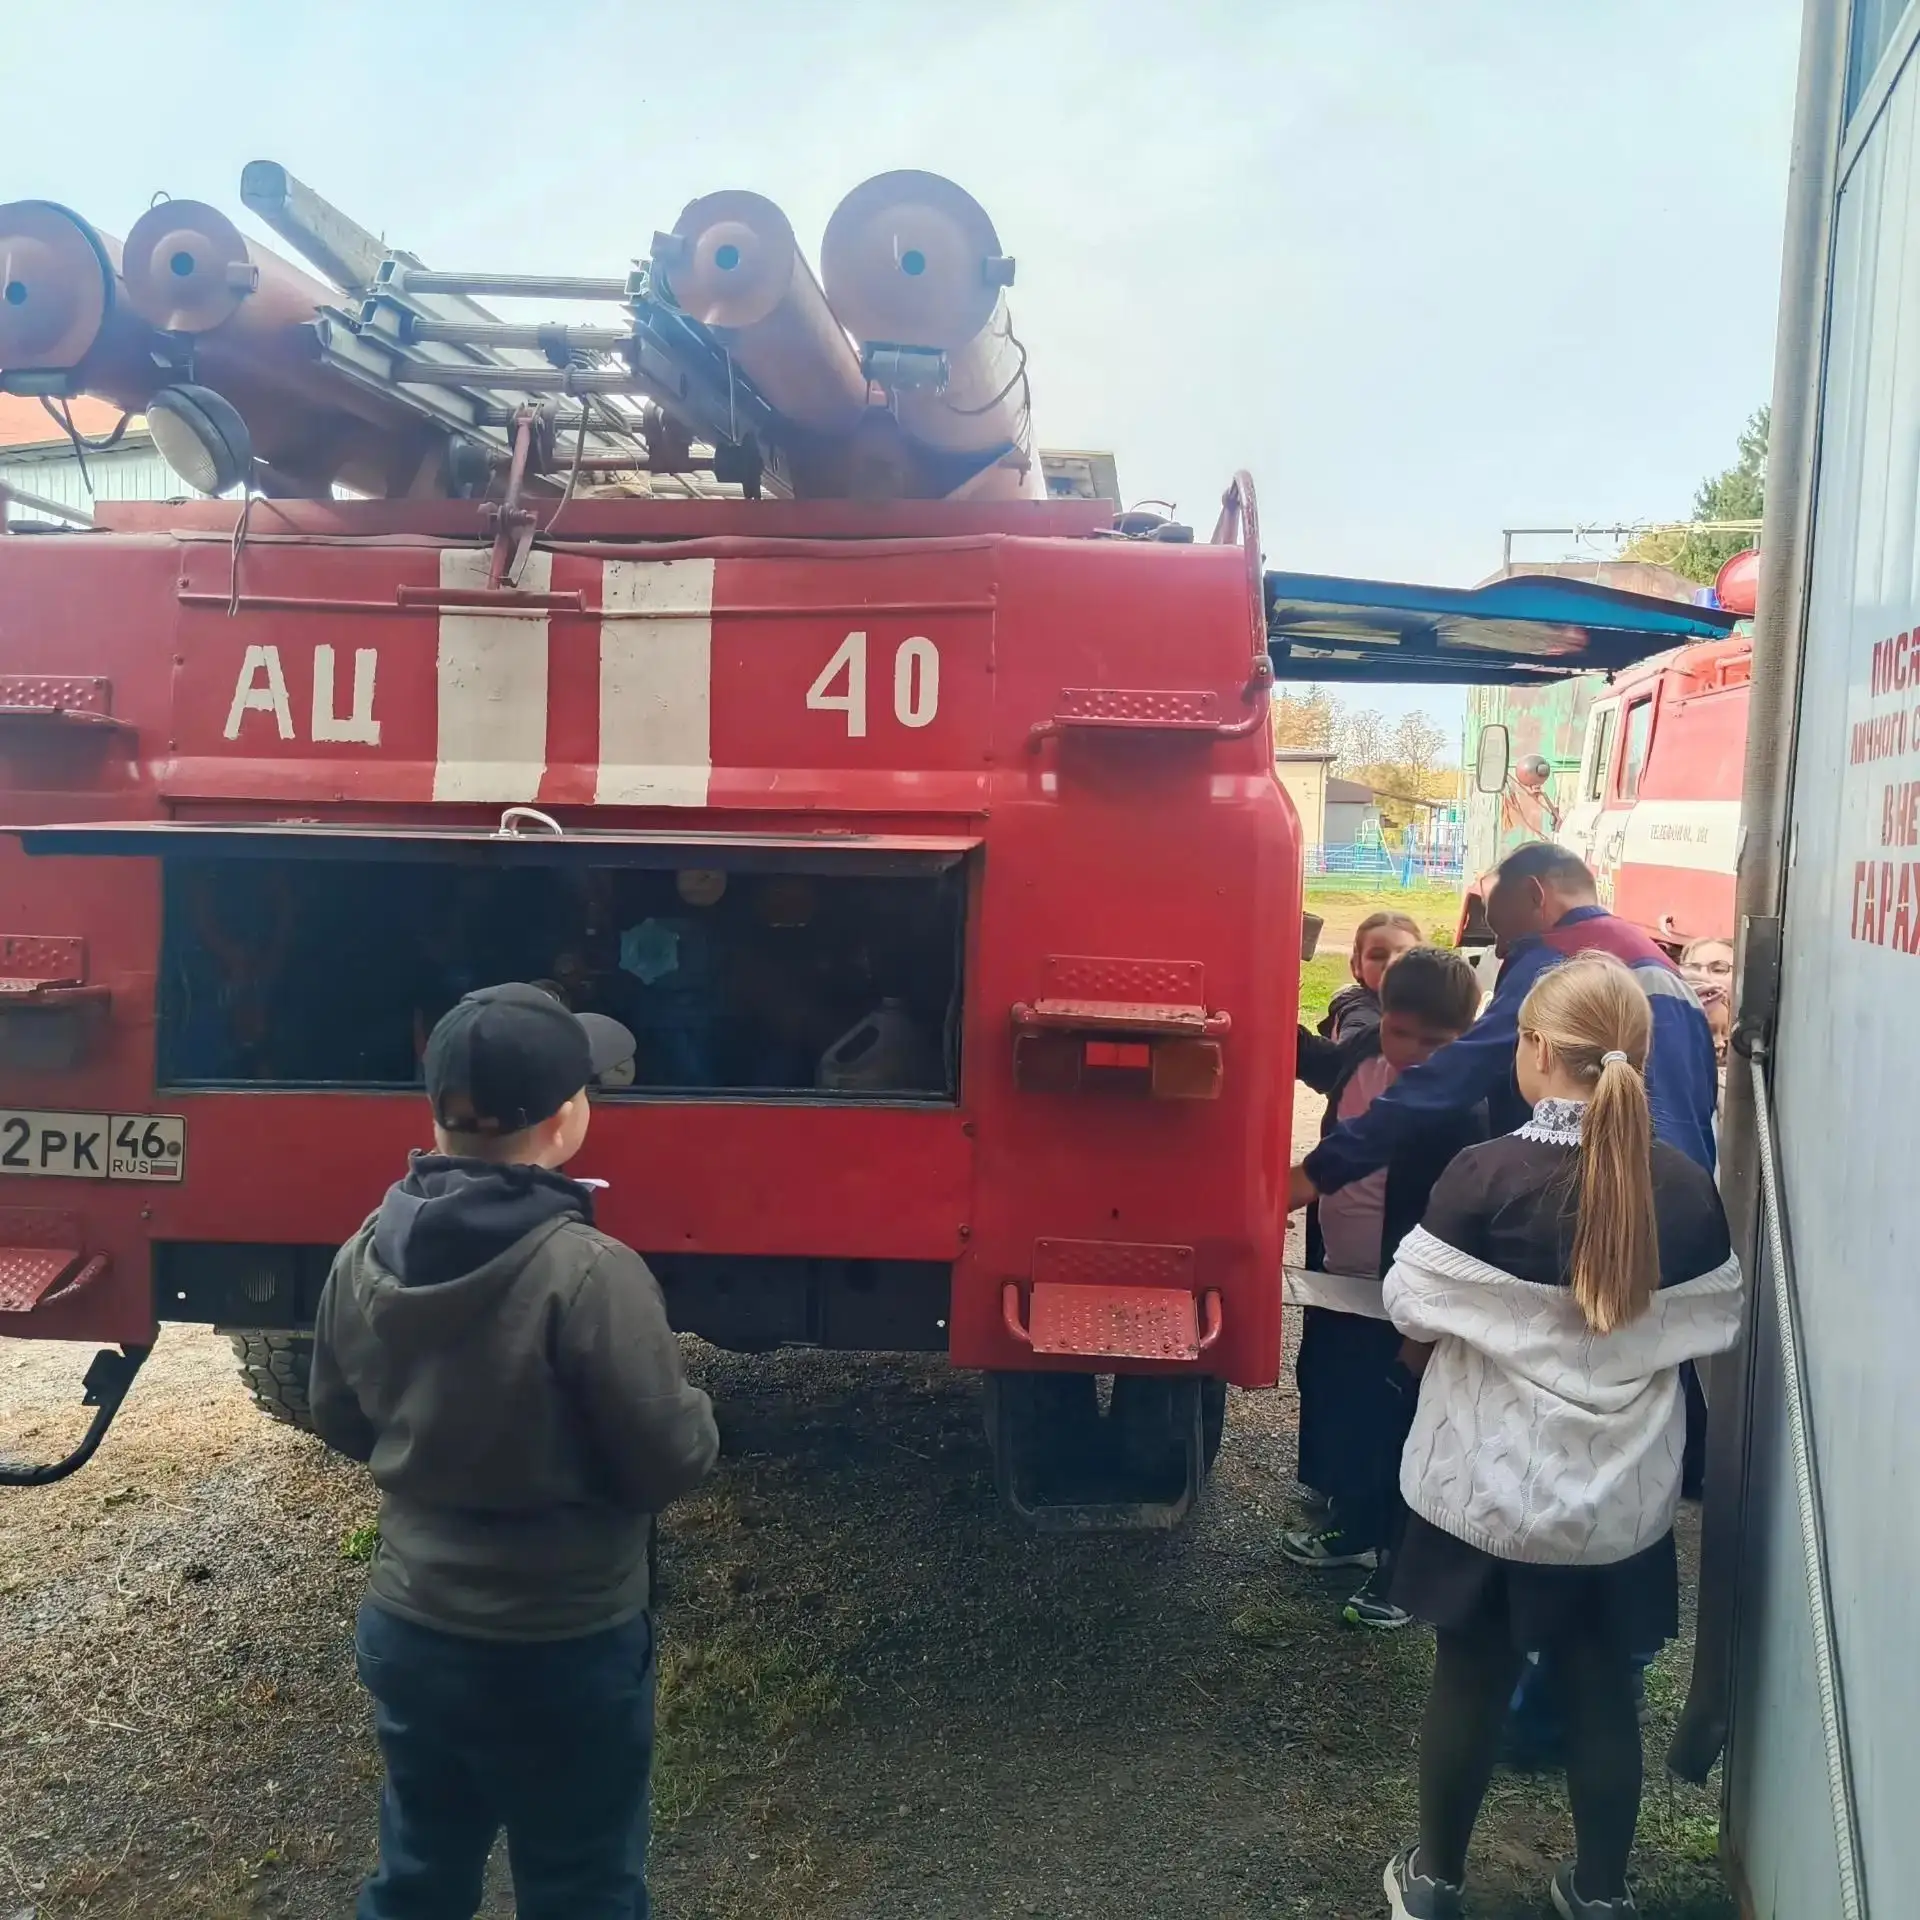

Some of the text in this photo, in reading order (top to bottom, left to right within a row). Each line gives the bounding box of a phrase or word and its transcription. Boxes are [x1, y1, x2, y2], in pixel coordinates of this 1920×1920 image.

[222, 631, 940, 746] АЦ 40
[1850, 709, 1908, 766] ЛИЧНОГО
[116, 1120, 165, 1158] 46
[112, 1159, 149, 1174] RUS
